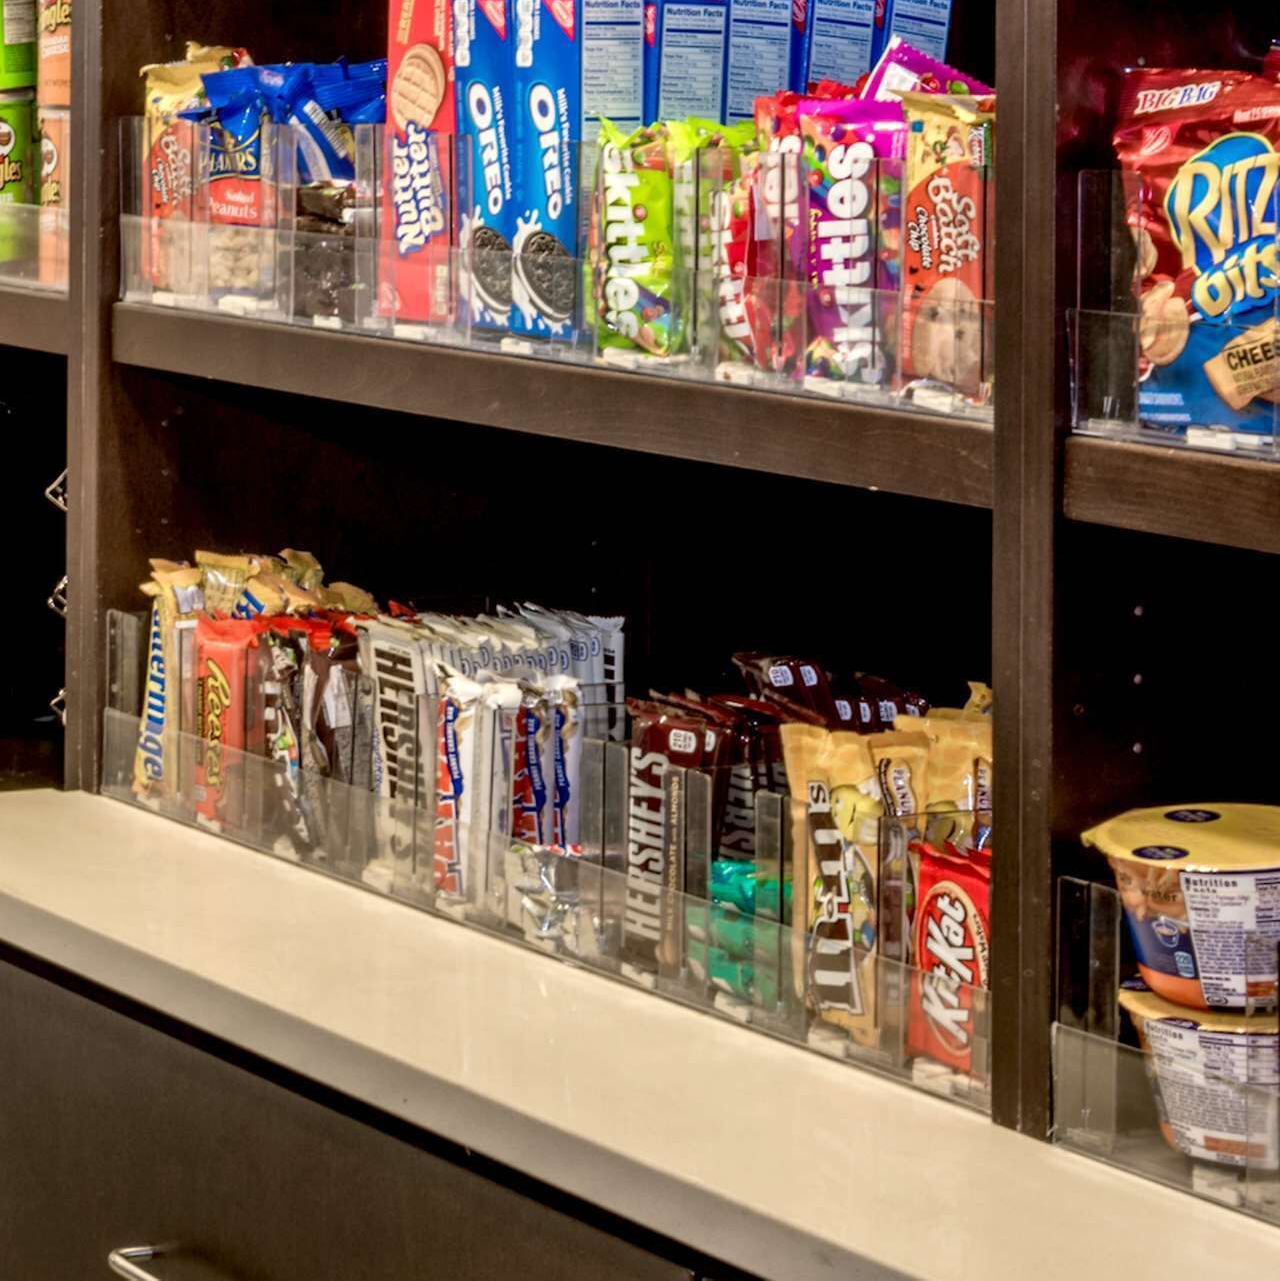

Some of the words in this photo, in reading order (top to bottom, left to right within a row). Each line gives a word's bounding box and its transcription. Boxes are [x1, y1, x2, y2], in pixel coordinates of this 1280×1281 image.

[584, 0, 619, 9] Nutrition
[620, 0, 641, 9] Facts
[666, 7, 700, 17] Nutrition
[702, 8, 724, 18] Facts
[767, 0, 790, 12] Facts
[851, 0, 874, 12] Facts
[406, 119, 444, 237] Butter
[468, 81, 503, 215] OREO
[530, 83, 562, 220] OREO
[394, 134, 425, 256] Nutter
[670, 775, 680, 827] ALMONDS
[624, 746, 669, 942] HERSHEY'S
